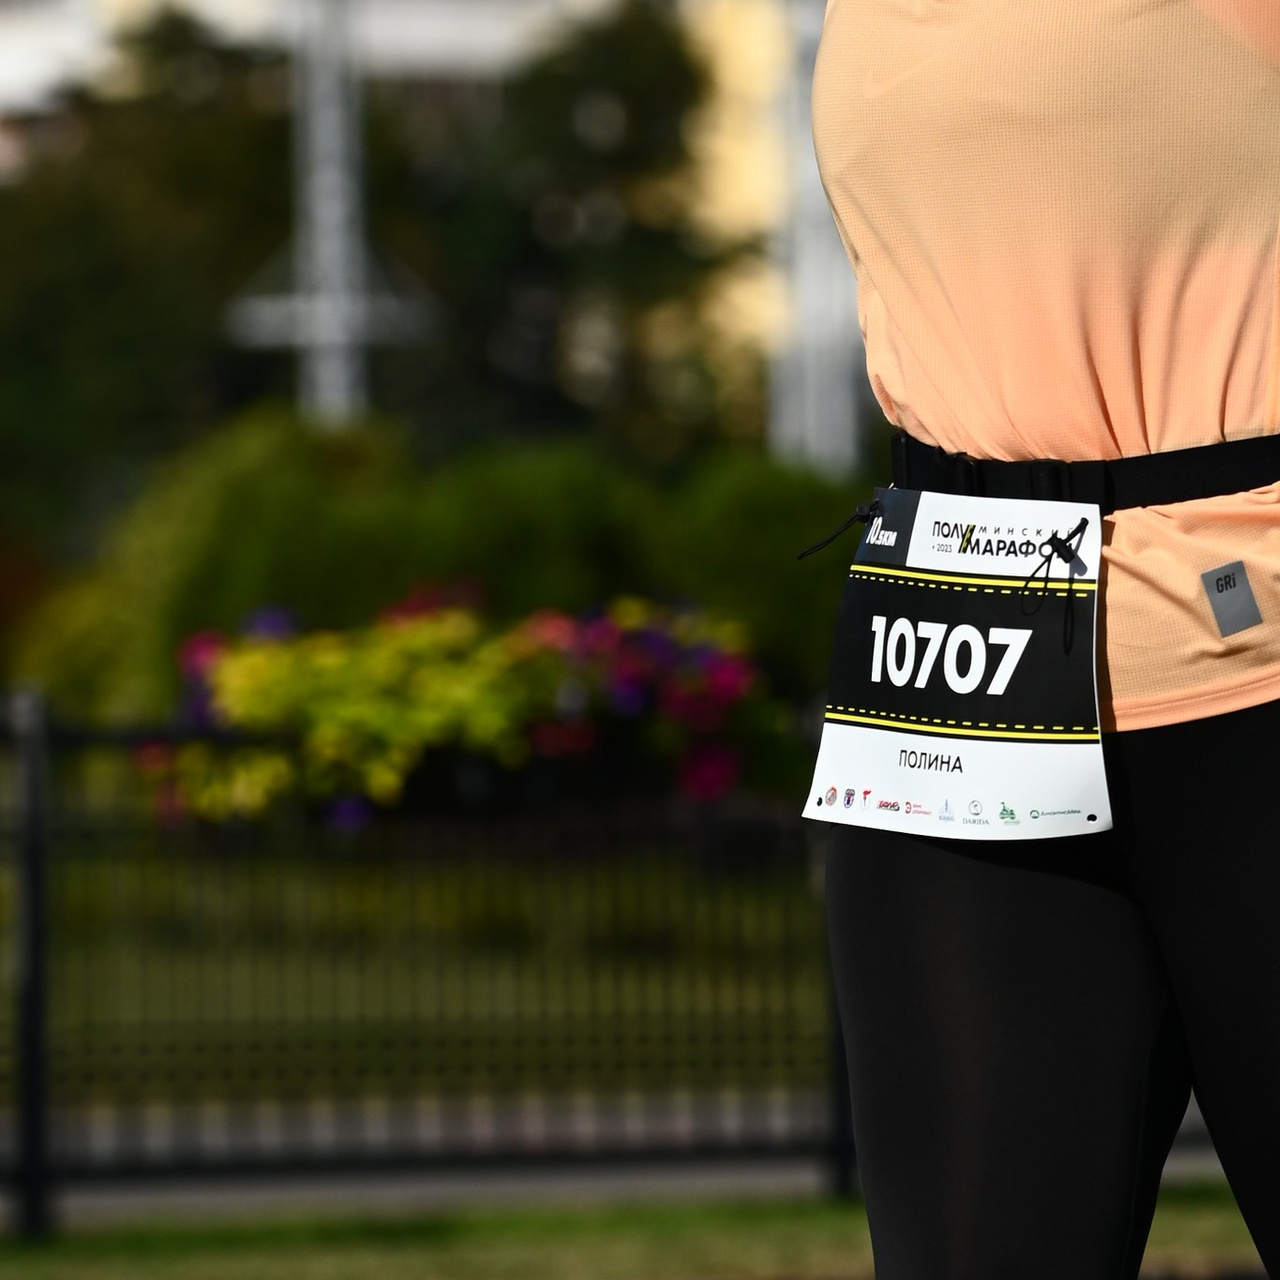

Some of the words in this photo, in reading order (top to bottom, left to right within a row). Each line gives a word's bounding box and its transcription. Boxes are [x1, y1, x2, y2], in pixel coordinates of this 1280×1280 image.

[978, 524, 1075, 539] МИНСКИ
[963, 537, 1072, 559] МАРАФО
[871, 615, 1033, 696] 10707
[899, 749, 963, 773] ПОЛИНА
